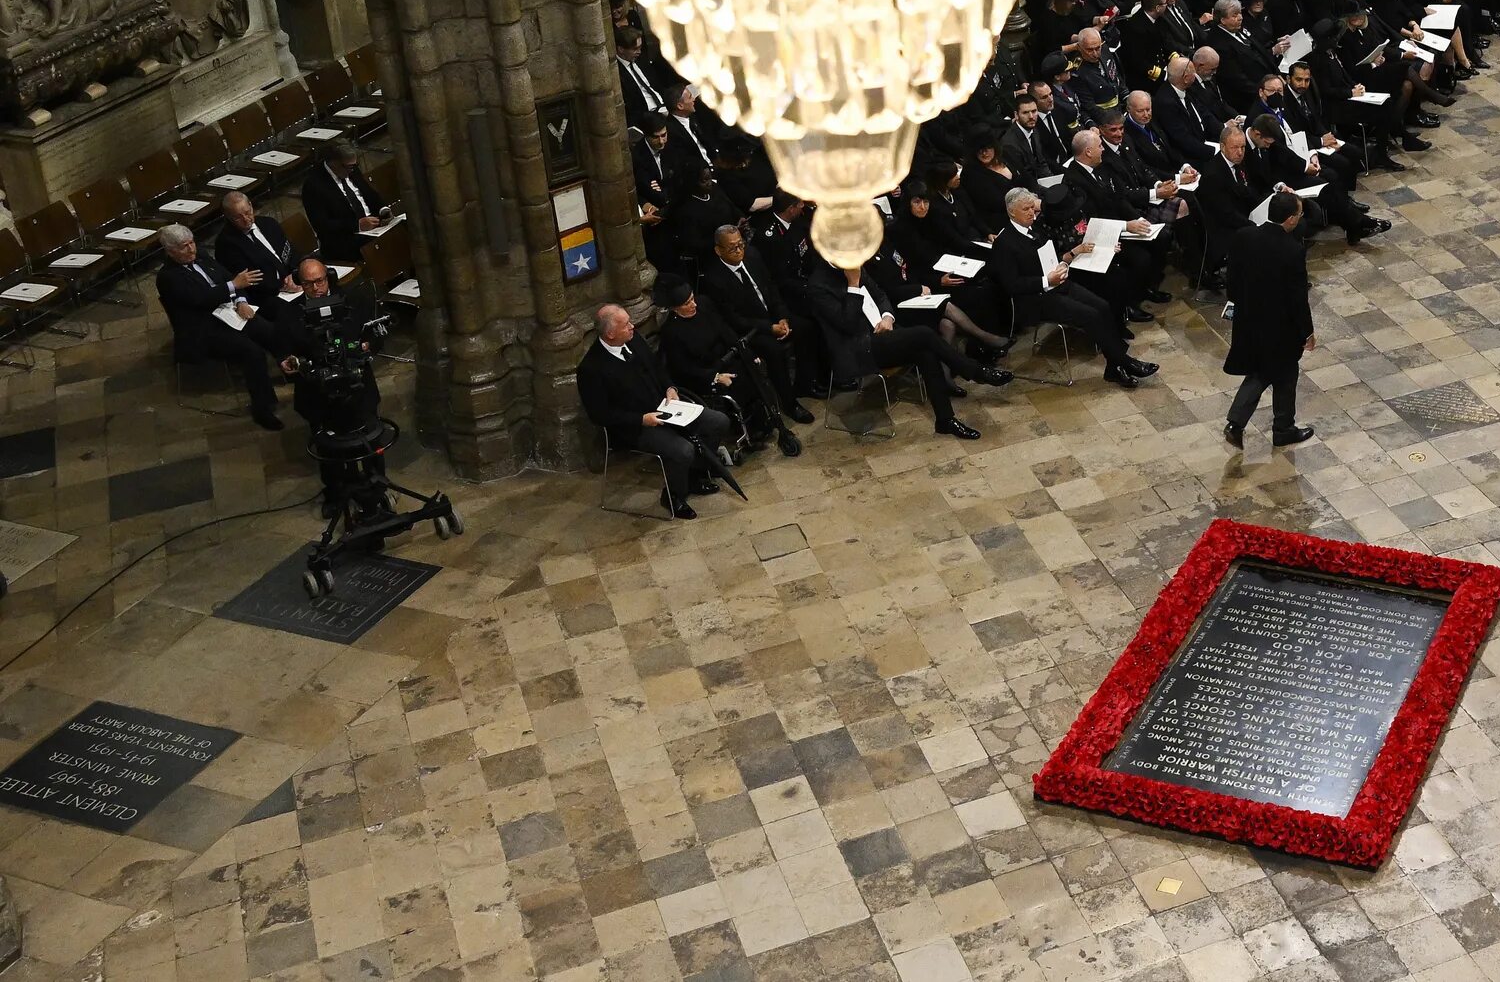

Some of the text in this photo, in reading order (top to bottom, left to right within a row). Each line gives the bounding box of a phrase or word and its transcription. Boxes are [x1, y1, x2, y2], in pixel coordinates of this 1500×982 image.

[547, 118, 569, 143] Y
[1241, 583, 1275, 593] TOWARD
[1248, 591, 1284, 602] BECAUSE
[1315, 590, 1343, 599] HOUSE
[1285, 598, 1309, 607] KINGS
[1318, 598, 1353, 608] TOWARD
[1354, 604, 1381, 613] GOOD
[1226, 607, 1247, 615] AND
[1251, 604, 1287, 614] WORLD
[1328, 606, 1359, 616] AMONG
[1382, 610, 1407, 618] DONE
[1248, 611, 1288, 623] JUSTICE
[1408, 614, 1427, 622] HAD
[1304, 622, 1337, 632] CAUSE
[1328, 618, 1375, 631] FREEDOM
[1402, 620, 1423, 628] THEY
[1221, 614, 1411, 655] FOR LOVED ONES HOME AND EMPIRE
[1336, 628, 1374, 639] SACRED
[1376, 627, 1397, 635] THE
[1231, 624, 1392, 660] FOR KING AND COUNTRY
[1374, 635, 1393, 643] THE
[1394, 639, 1415, 647] FOR
[1270, 641, 1343, 660] FOR GOD
[1219, 640, 1383, 676] MAN CAN GIVE LIFE ITSELF
[1201, 645, 1394, 688] WAR OF 1914-1918 GAVE THE MOST THAT
[1183, 672, 1223, 684] NATION
[1197, 653, 1391, 696] MULTITUDES WHO DURING THE GREAT
[1192, 661, 1385, 704] THUS ARE COMMEMORATED THE MANY
[1222, 679, 1242, 688] THE
[1241, 683, 1256, 691] OF
[1257, 686, 1321, 704] CONCOURSE
[1196, 683, 1358, 721] THE CHIEFS OF HIS FORCES
[1322, 699, 1350, 710] VAST
[1161, 706, 1178, 714] OF
[1181, 700, 1237, 717] GEORGE
[1190, 692, 1354, 730] HIS MINISTERS OF STATE
[1356, 706, 1380, 716] AND
[1181, 710, 1237, 726] PRESENCE
[1239, 712, 1274, 725] KING
[92, 715, 212, 748] OF THE LABOUR PARTY
[1242, 723, 1264, 732] THE
[1276, 719, 1339, 738] MAJESTY
[69, 721, 212, 761] FOR TWENTY YEARS LEADER
[1156, 715, 1358, 761] AND BURIED HERE ON ARMISTICE DAY
[1343, 732, 1367, 744] HIS
[1150, 723, 1353, 770] THE MOST ILLUSTRIOUS OF THE LAND
[87, 743, 157, 766] 1945-1951
[1146, 732, 1349, 778] BROUGHT FROM FRANCE TO LIE AMONG
[48, 751, 160, 786] PRIME MINISTER
[1128, 759, 1159, 770] BODY
[1162, 744, 1321, 783] UNKNOWN BY NAME OR RANK
[1156, 753, 1316, 793] OF A BRITISH WARRIOR
[1160, 765, 1182, 775] THE
[1189, 771, 1218, 782] RESTS
[48, 770, 124, 797] 1883-1967
[1219, 778, 1256, 790] STONE
[1258, 786, 1283, 796] THIS
[0, 777, 139, 820] CLEMENT ATTLEE
